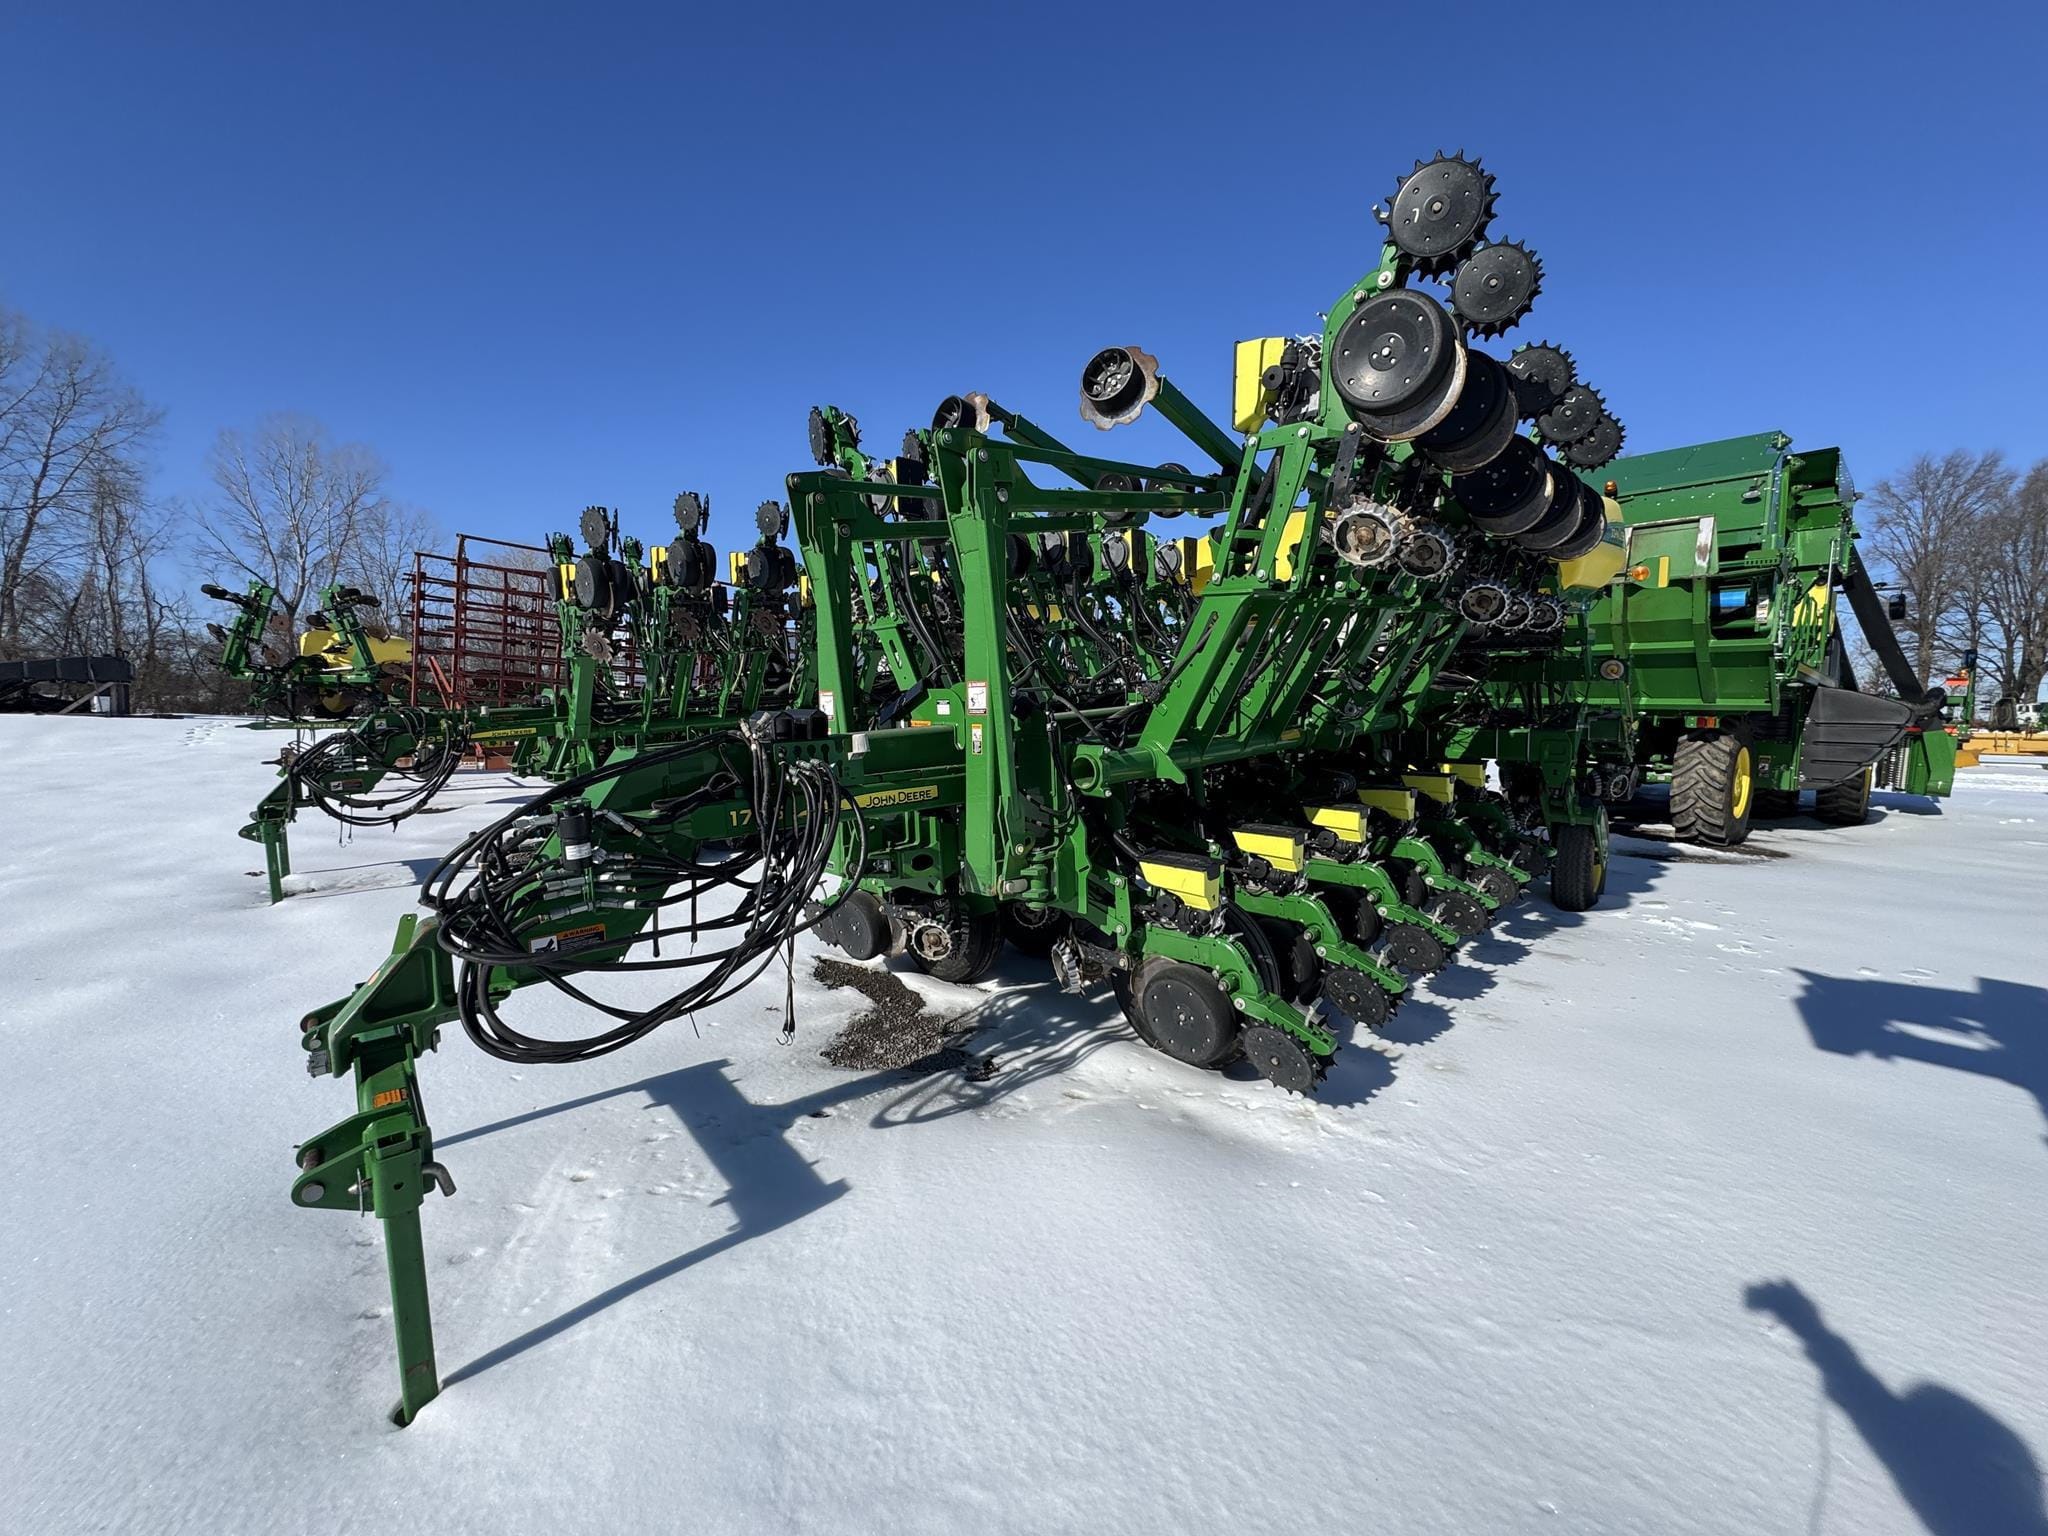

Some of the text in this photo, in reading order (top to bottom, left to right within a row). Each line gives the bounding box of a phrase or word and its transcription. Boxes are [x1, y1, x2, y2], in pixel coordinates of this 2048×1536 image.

[866, 788, 932, 809] JOHN DEERE
[569, 926, 600, 937] WARNING
